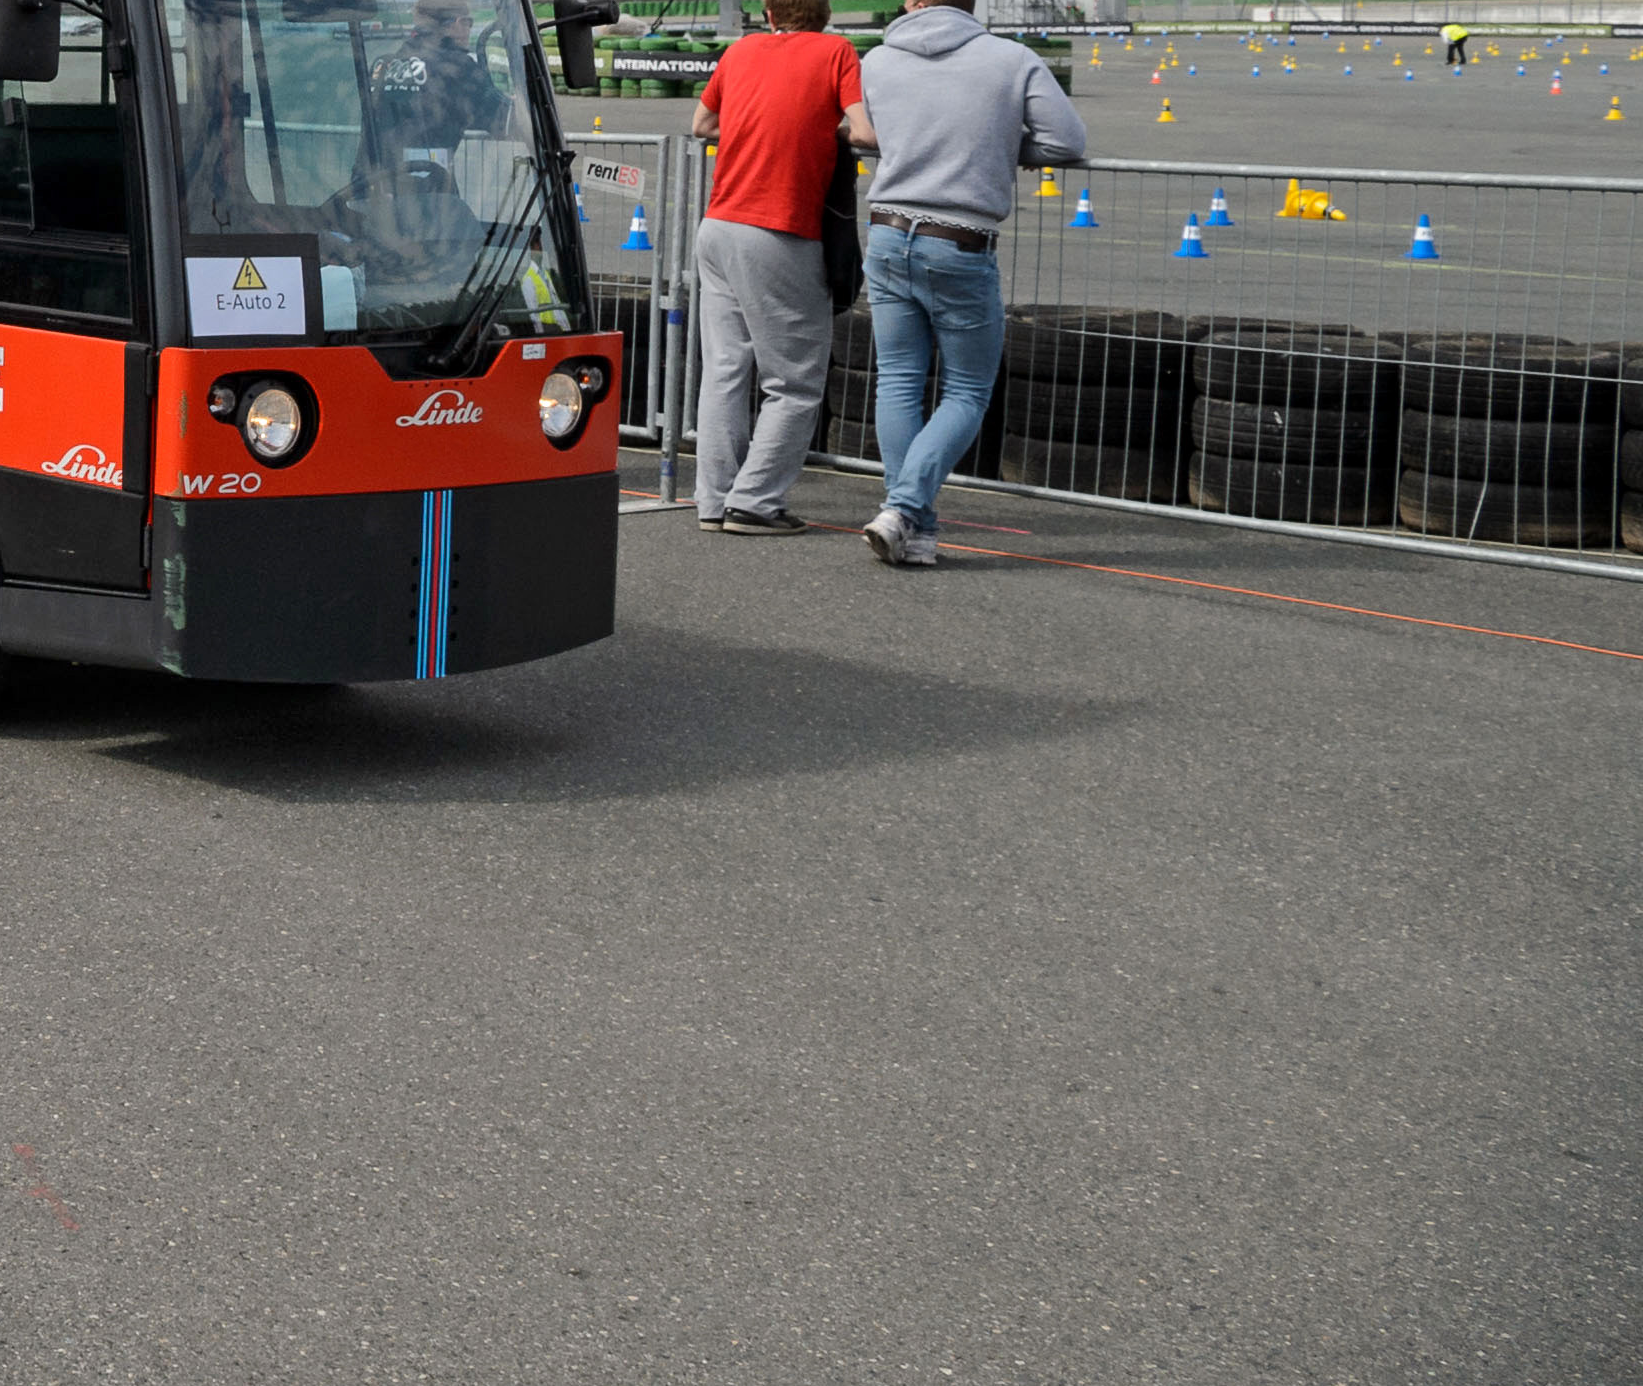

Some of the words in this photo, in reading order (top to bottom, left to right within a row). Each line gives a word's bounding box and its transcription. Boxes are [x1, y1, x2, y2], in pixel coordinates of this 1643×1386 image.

[613, 57, 719, 74] INTERNATIONA
[587, 162, 640, 187] rentES
[216, 293, 272, 311] E-Auto
[276, 292, 287, 310] 2
[396, 389, 484, 427] Linde
[41, 444, 123, 486] Linde
[182, 474, 214, 495] W
[218, 472, 262, 494] 20
